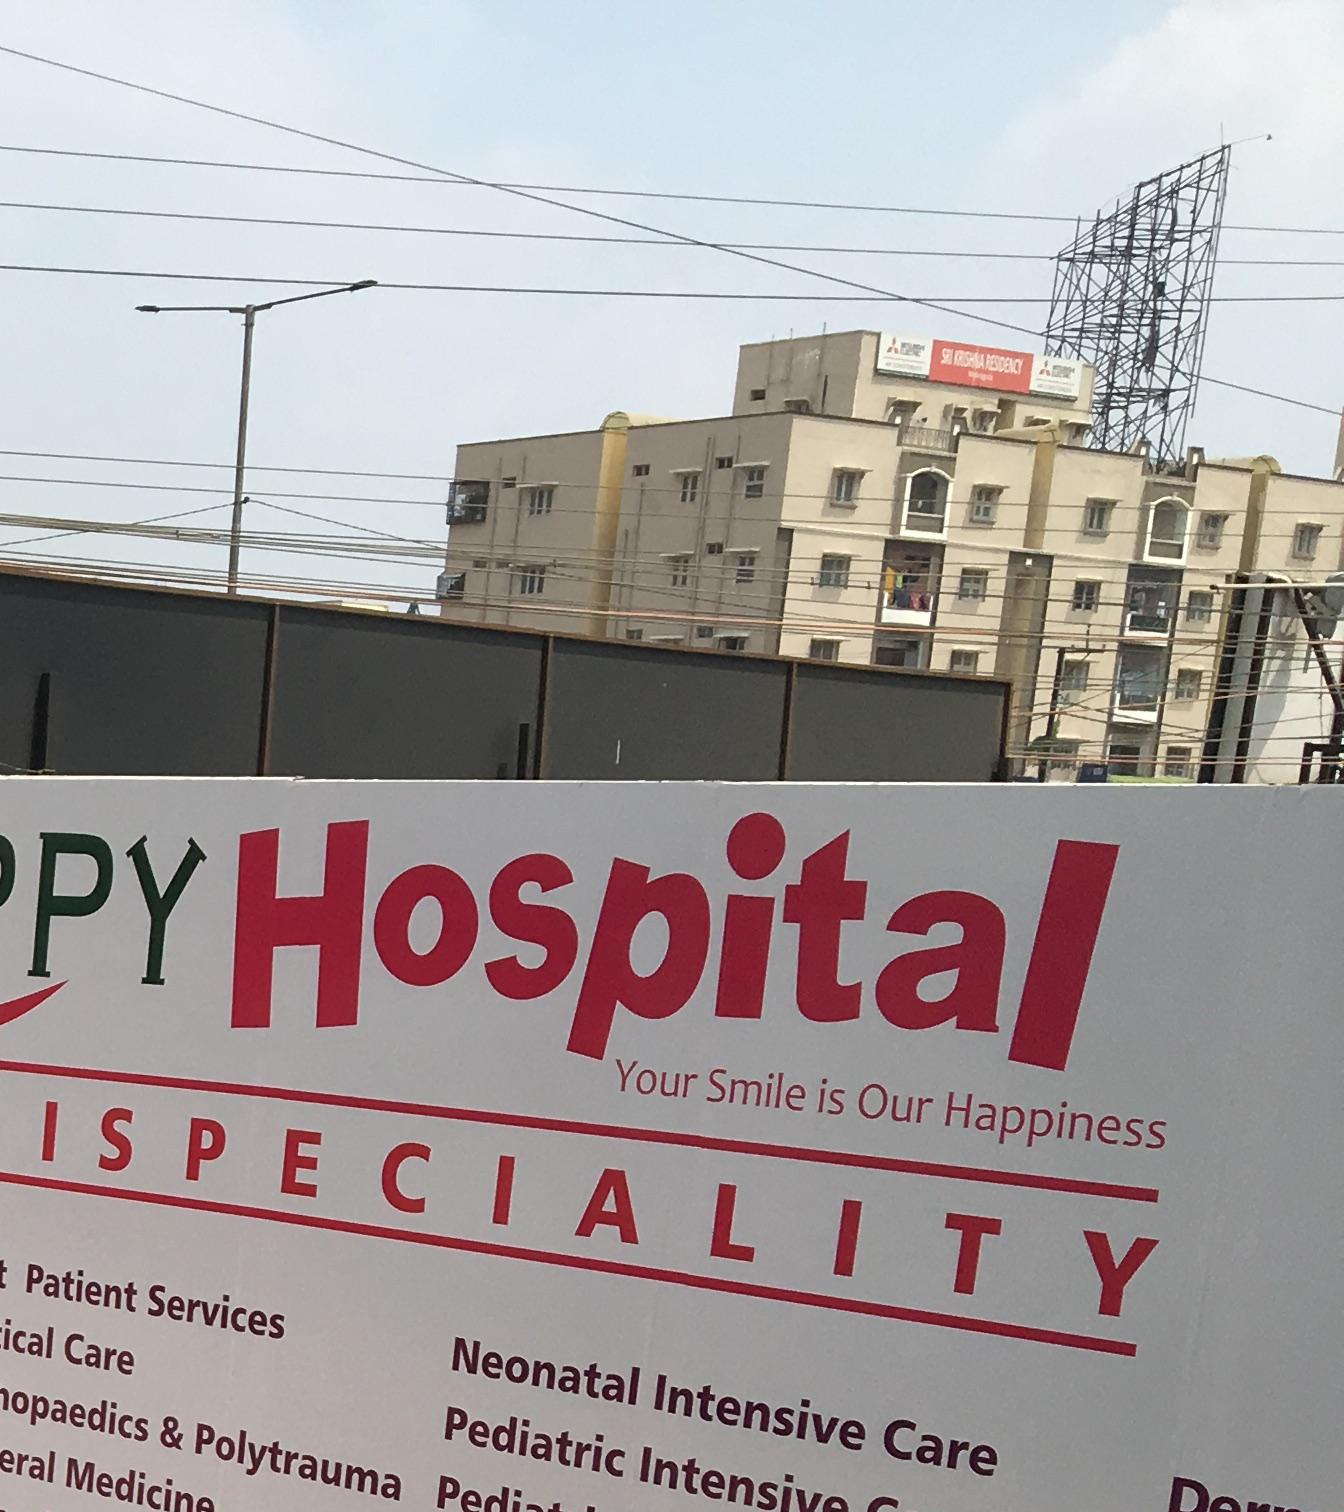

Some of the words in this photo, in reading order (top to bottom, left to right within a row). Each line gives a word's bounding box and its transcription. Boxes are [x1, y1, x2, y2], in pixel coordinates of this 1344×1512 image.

[986, 354, 1024, 375] RESIDENCY
[231, 811, 1120, 1071] Hospital
[615, 1059, 697, 1098] Your
[706, 1068, 806, 1112] Smile
[818, 1078, 845, 1115] is
[858, 1083, 933, 1124] Our
[945, 1092, 1167, 1150] Happiness
[26, 1264, 138, 1313] Patient
[148, 1285, 285, 1340] Services
[66, 1334, 135, 1375] Care
[445, 1407, 625, 1477] Pediatric
[452, 1338, 641, 1406] Neonatal
[654, 1375, 866, 1451] Intensive
[884, 1420, 998, 1477] Care
[160, 1416, 184, 1451] &
[195, 1424, 402, 1501] Polytrauma
